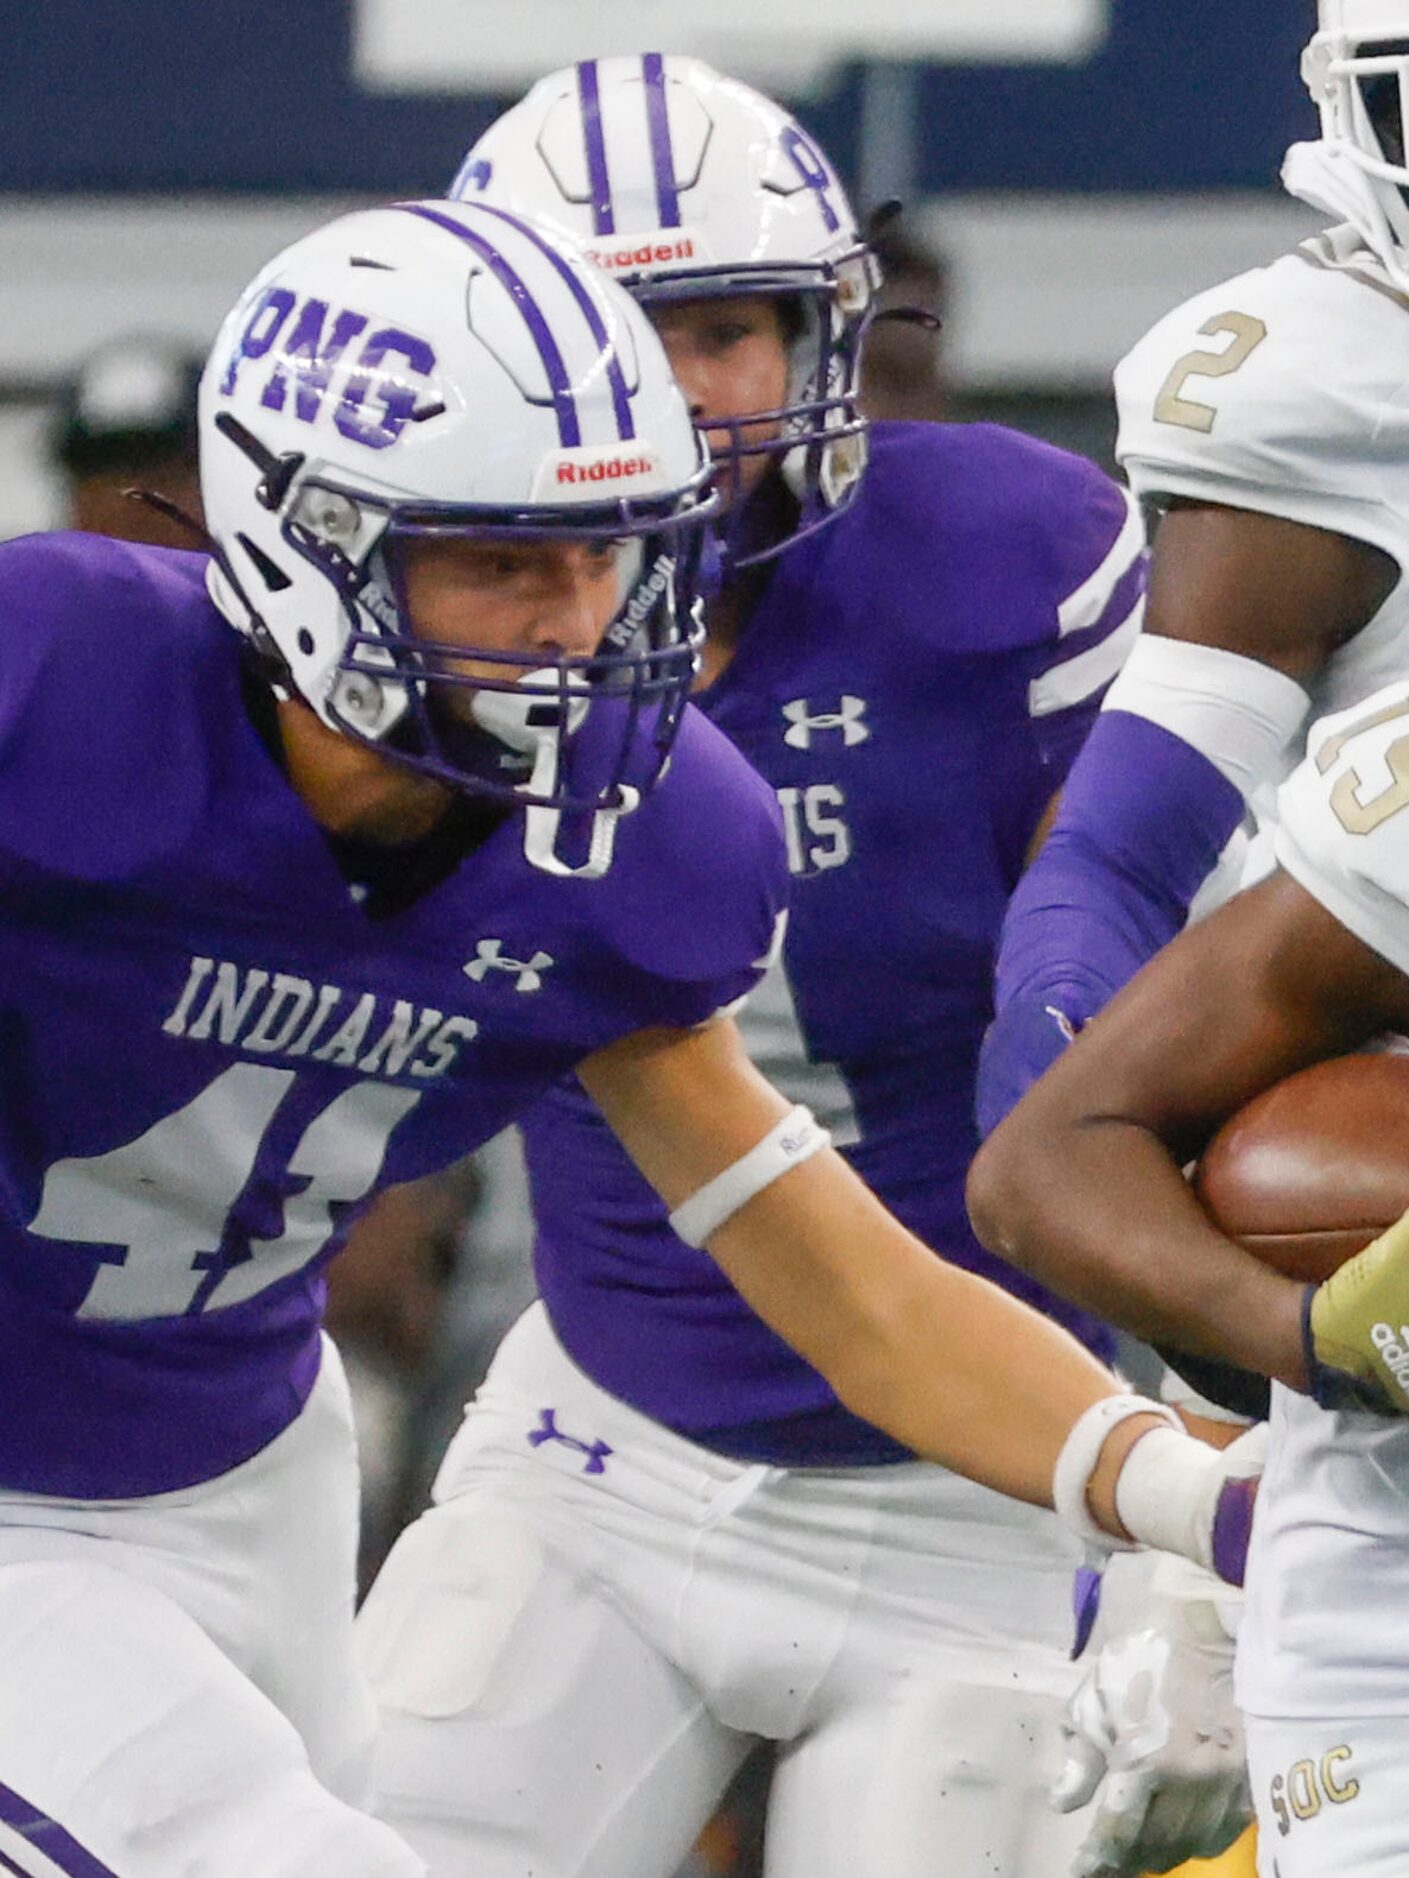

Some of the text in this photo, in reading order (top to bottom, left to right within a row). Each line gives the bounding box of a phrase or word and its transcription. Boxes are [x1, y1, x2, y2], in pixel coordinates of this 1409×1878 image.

[218, 287, 437, 450] PNG
[1152, 309, 1268, 435] 2
[607, 553, 668, 648] Riddell
[163, 957, 478, 1079] INDIANS
[27, 1061, 423, 1322] 41
[1270, 1744, 1360, 1838] SOC
